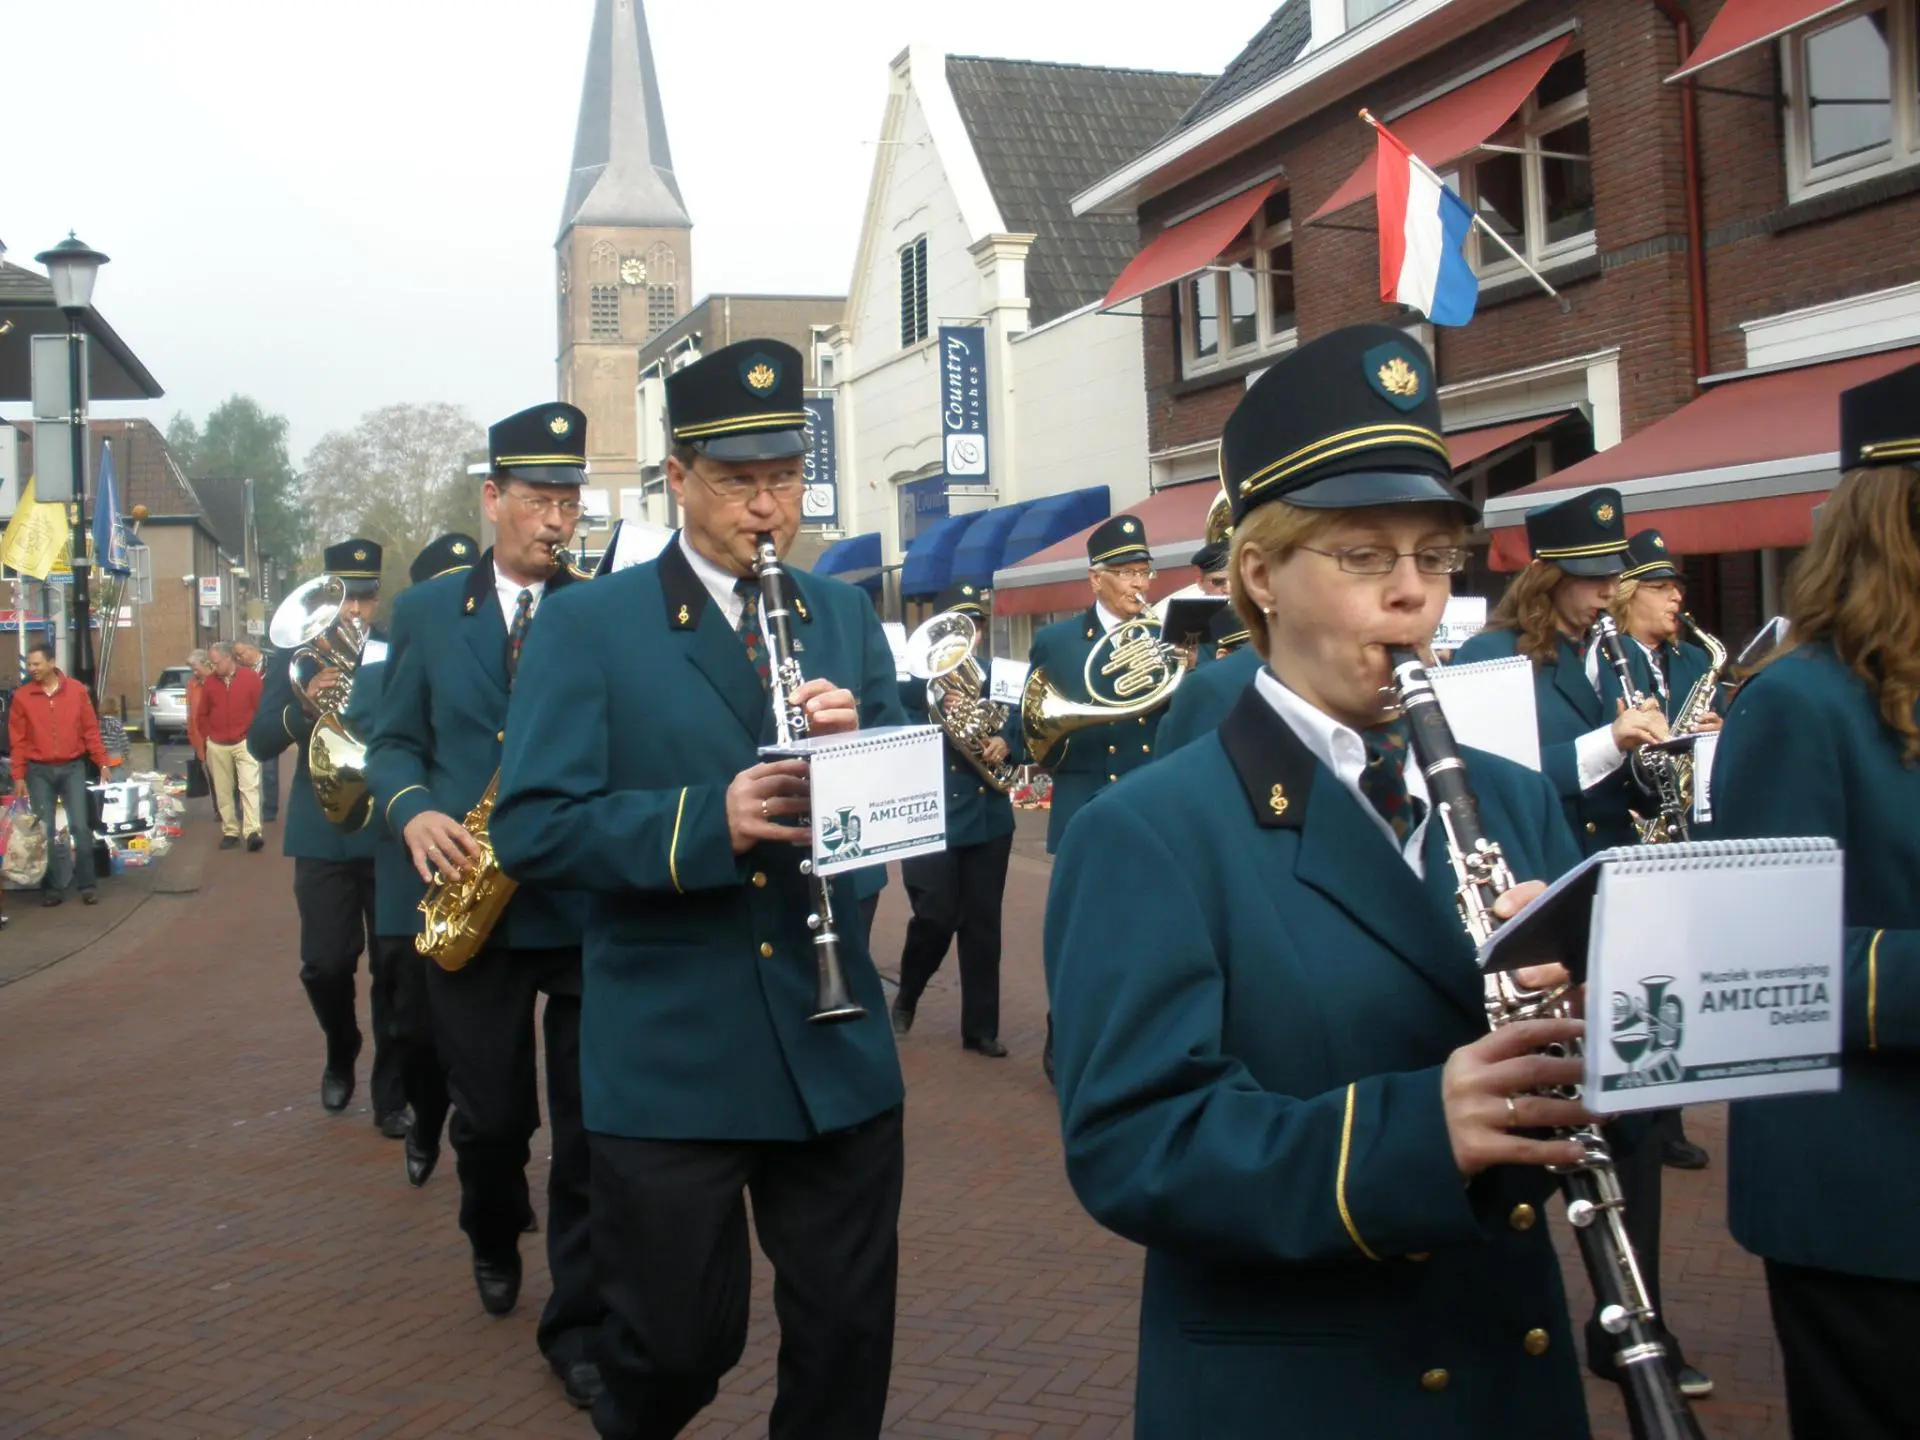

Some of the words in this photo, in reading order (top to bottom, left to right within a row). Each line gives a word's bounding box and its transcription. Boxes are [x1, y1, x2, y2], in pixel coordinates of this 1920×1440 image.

[945, 335, 970, 430] Country
[969, 365, 979, 430] wishes
[820, 430, 829, 480] wishes
[869, 799, 895, 808] Muziek
[898, 790, 938, 803] vereniging
[869, 800, 938, 823] AMICITIA
[907, 812, 939, 824] Delden
[1700, 969, 1750, 984] Muziek
[1754, 964, 1829, 981] vereniging
[1698, 983, 1829, 1014] AMICITIA
[1769, 1008, 1829, 1026] Delden
